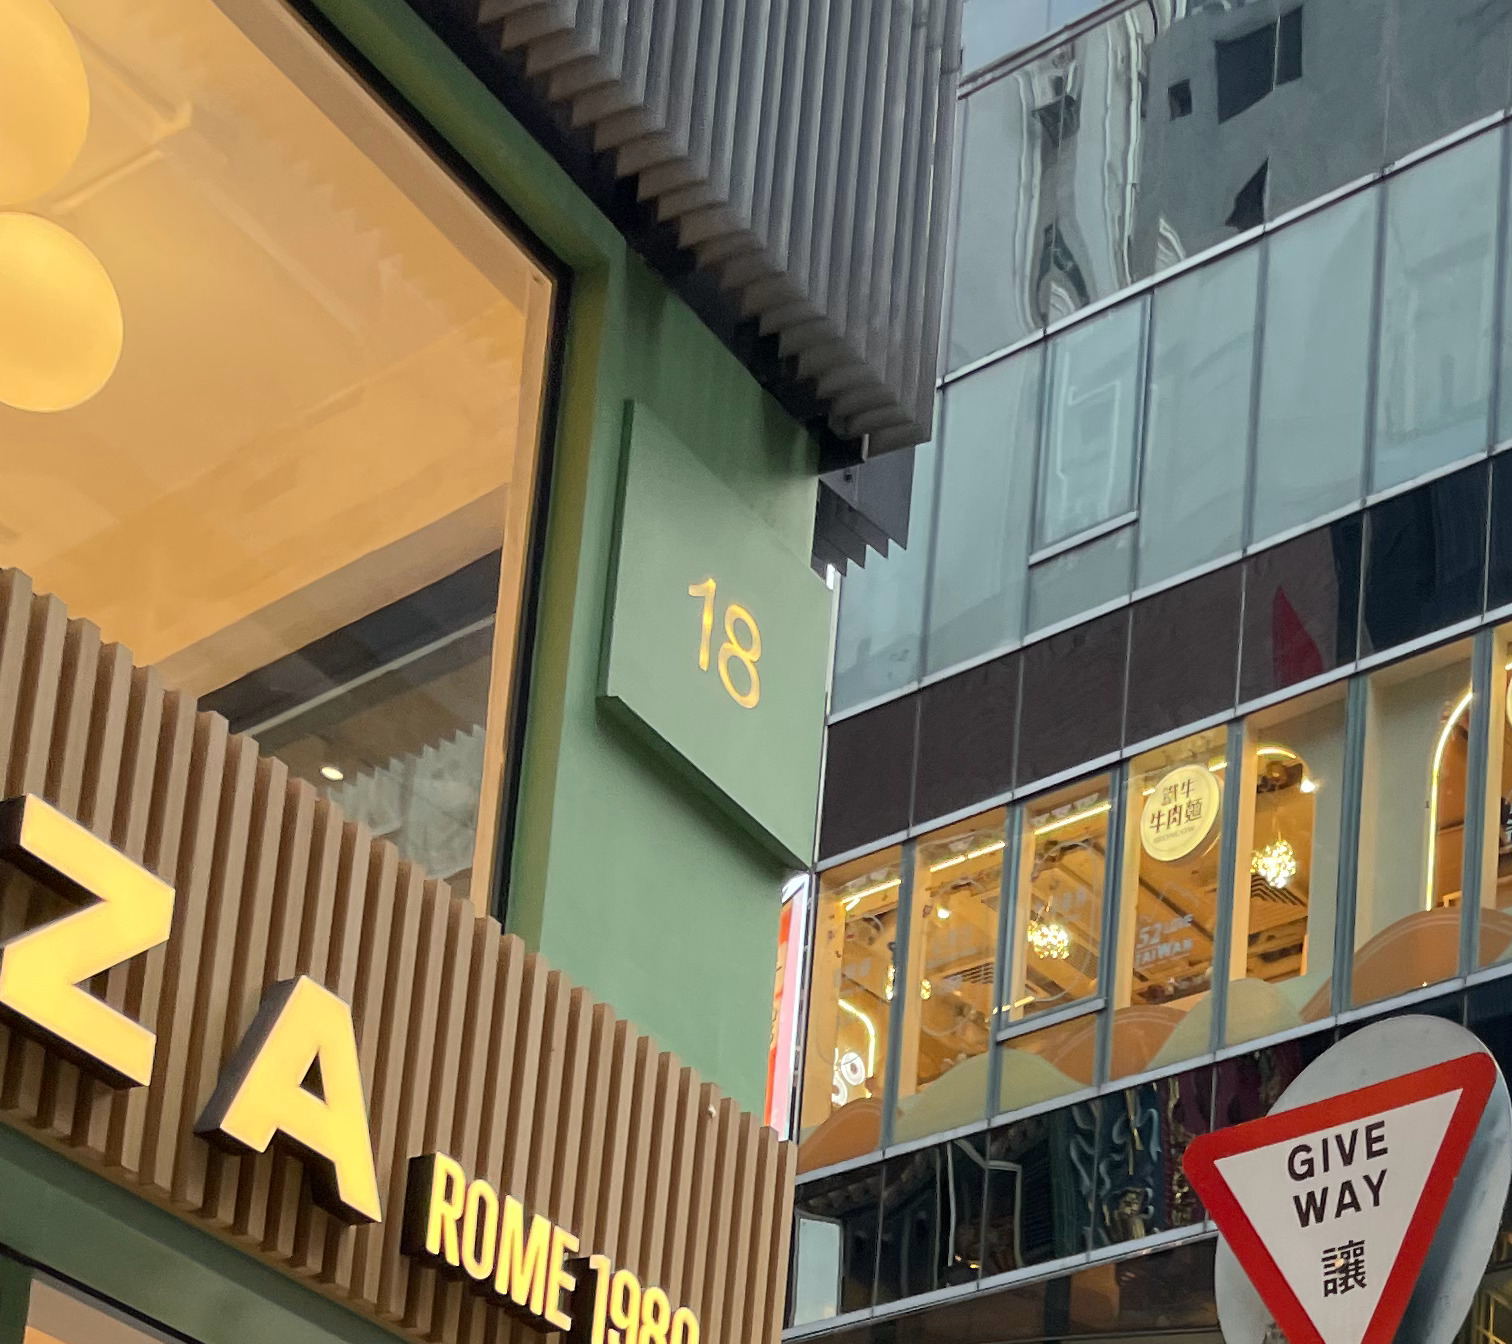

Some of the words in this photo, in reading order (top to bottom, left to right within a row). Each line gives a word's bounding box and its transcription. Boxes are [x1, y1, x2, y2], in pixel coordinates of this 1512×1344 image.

[687, 576, 763, 709] 18
[0, 793, 381, 1225] ZA
[1286, 1120, 1389, 1182] GIVE
[1293, 1170, 1388, 1228] WAY
[425, 1152, 581, 1334] ROME
[1322, 1239, 1366, 1296] 讓
